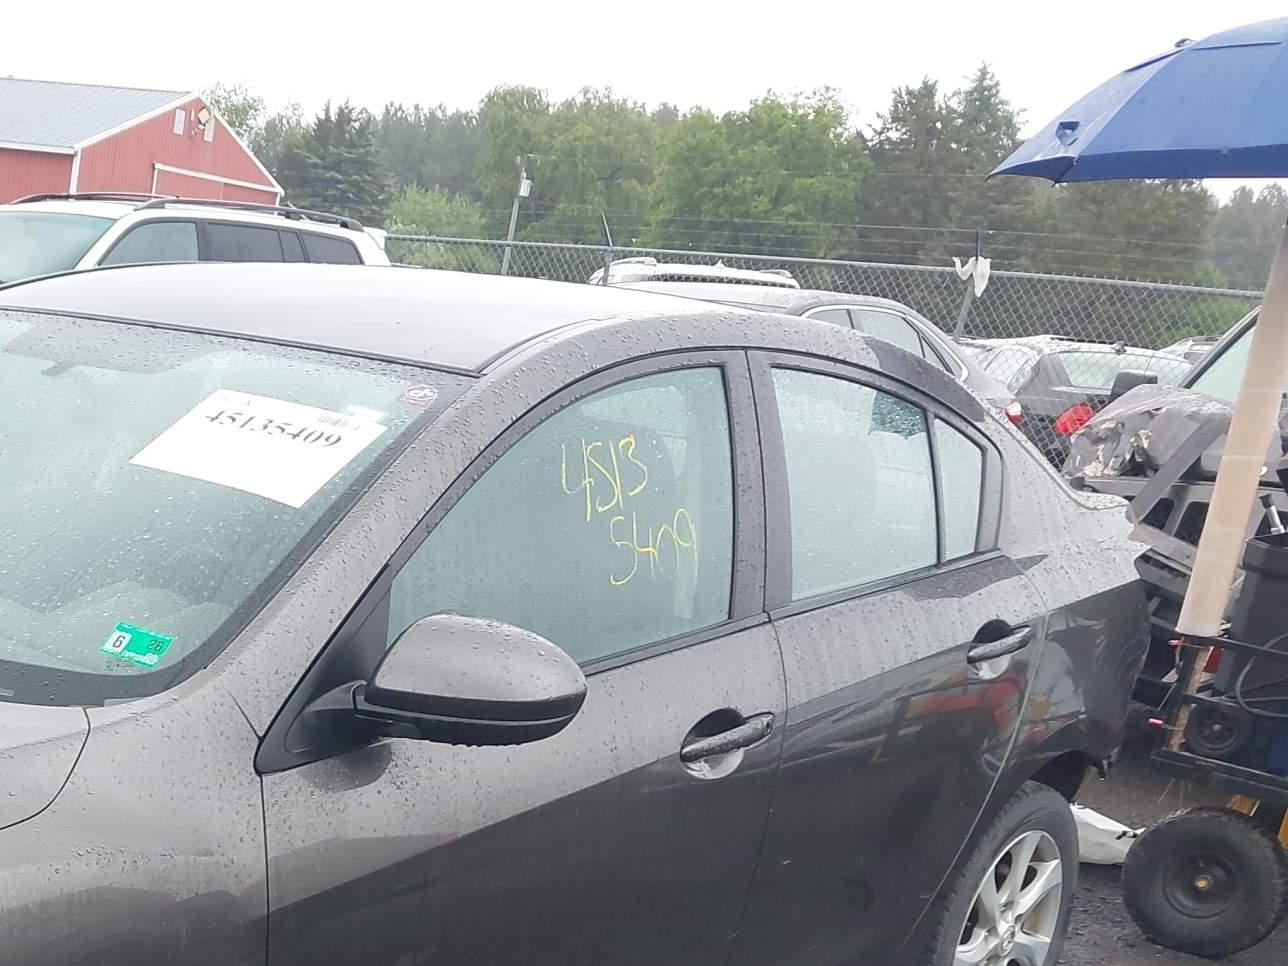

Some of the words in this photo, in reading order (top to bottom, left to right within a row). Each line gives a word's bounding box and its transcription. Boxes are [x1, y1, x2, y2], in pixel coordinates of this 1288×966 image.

[205, 410, 342, 447] 45135409
[561, 434, 648, 521] 4513
[112, 635, 126, 648] 6
